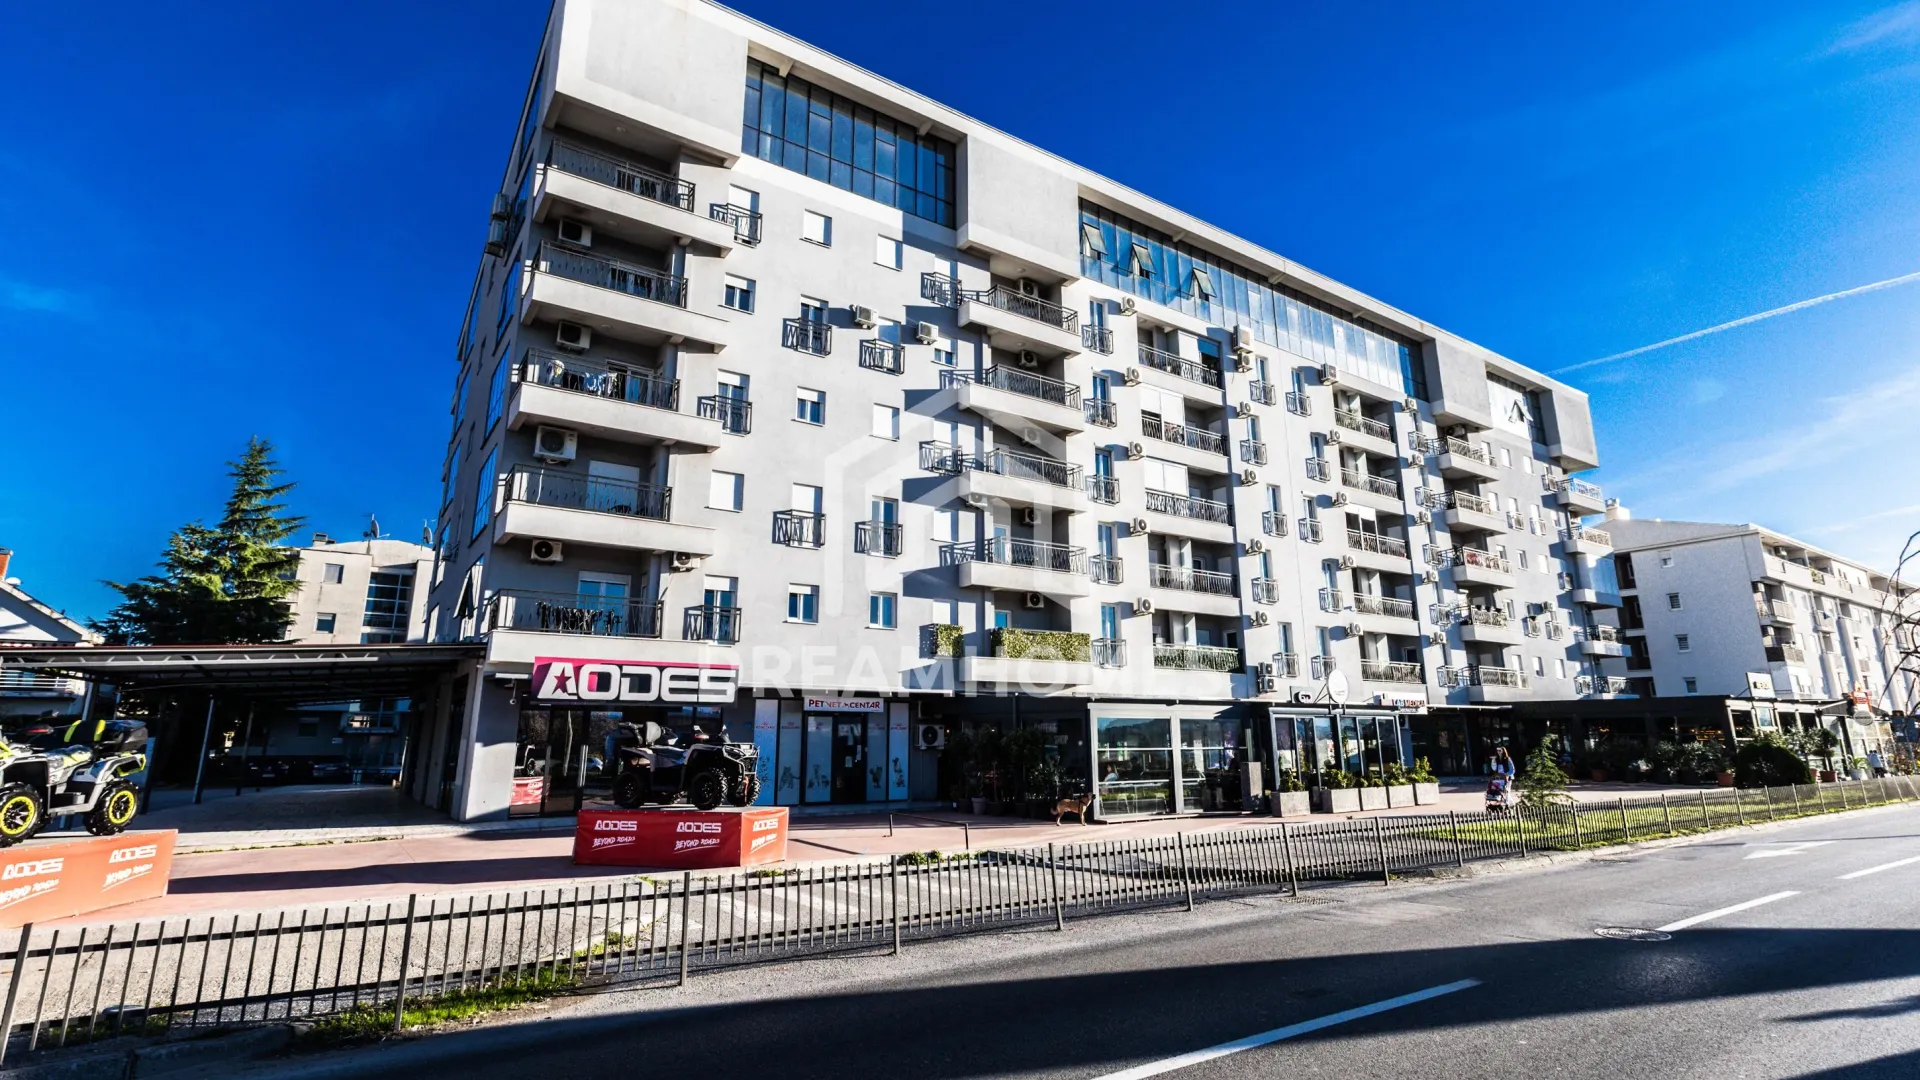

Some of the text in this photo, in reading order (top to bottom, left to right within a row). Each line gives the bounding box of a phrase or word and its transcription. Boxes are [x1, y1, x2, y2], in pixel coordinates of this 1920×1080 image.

[537, 662, 737, 703] AODES
[808, 699, 824, 708] PET
[850, 700, 880, 709] CENTAR
[594, 820, 638, 831] AODES
[676, 821, 722, 833] AODES
[752, 818, 779, 832] AODES
[593, 836, 615, 847] BEYOND
[674, 838, 720, 850] BEYOND ROADS
[109, 845, 158, 863] AODES
[2, 857, 64, 880] AODES
